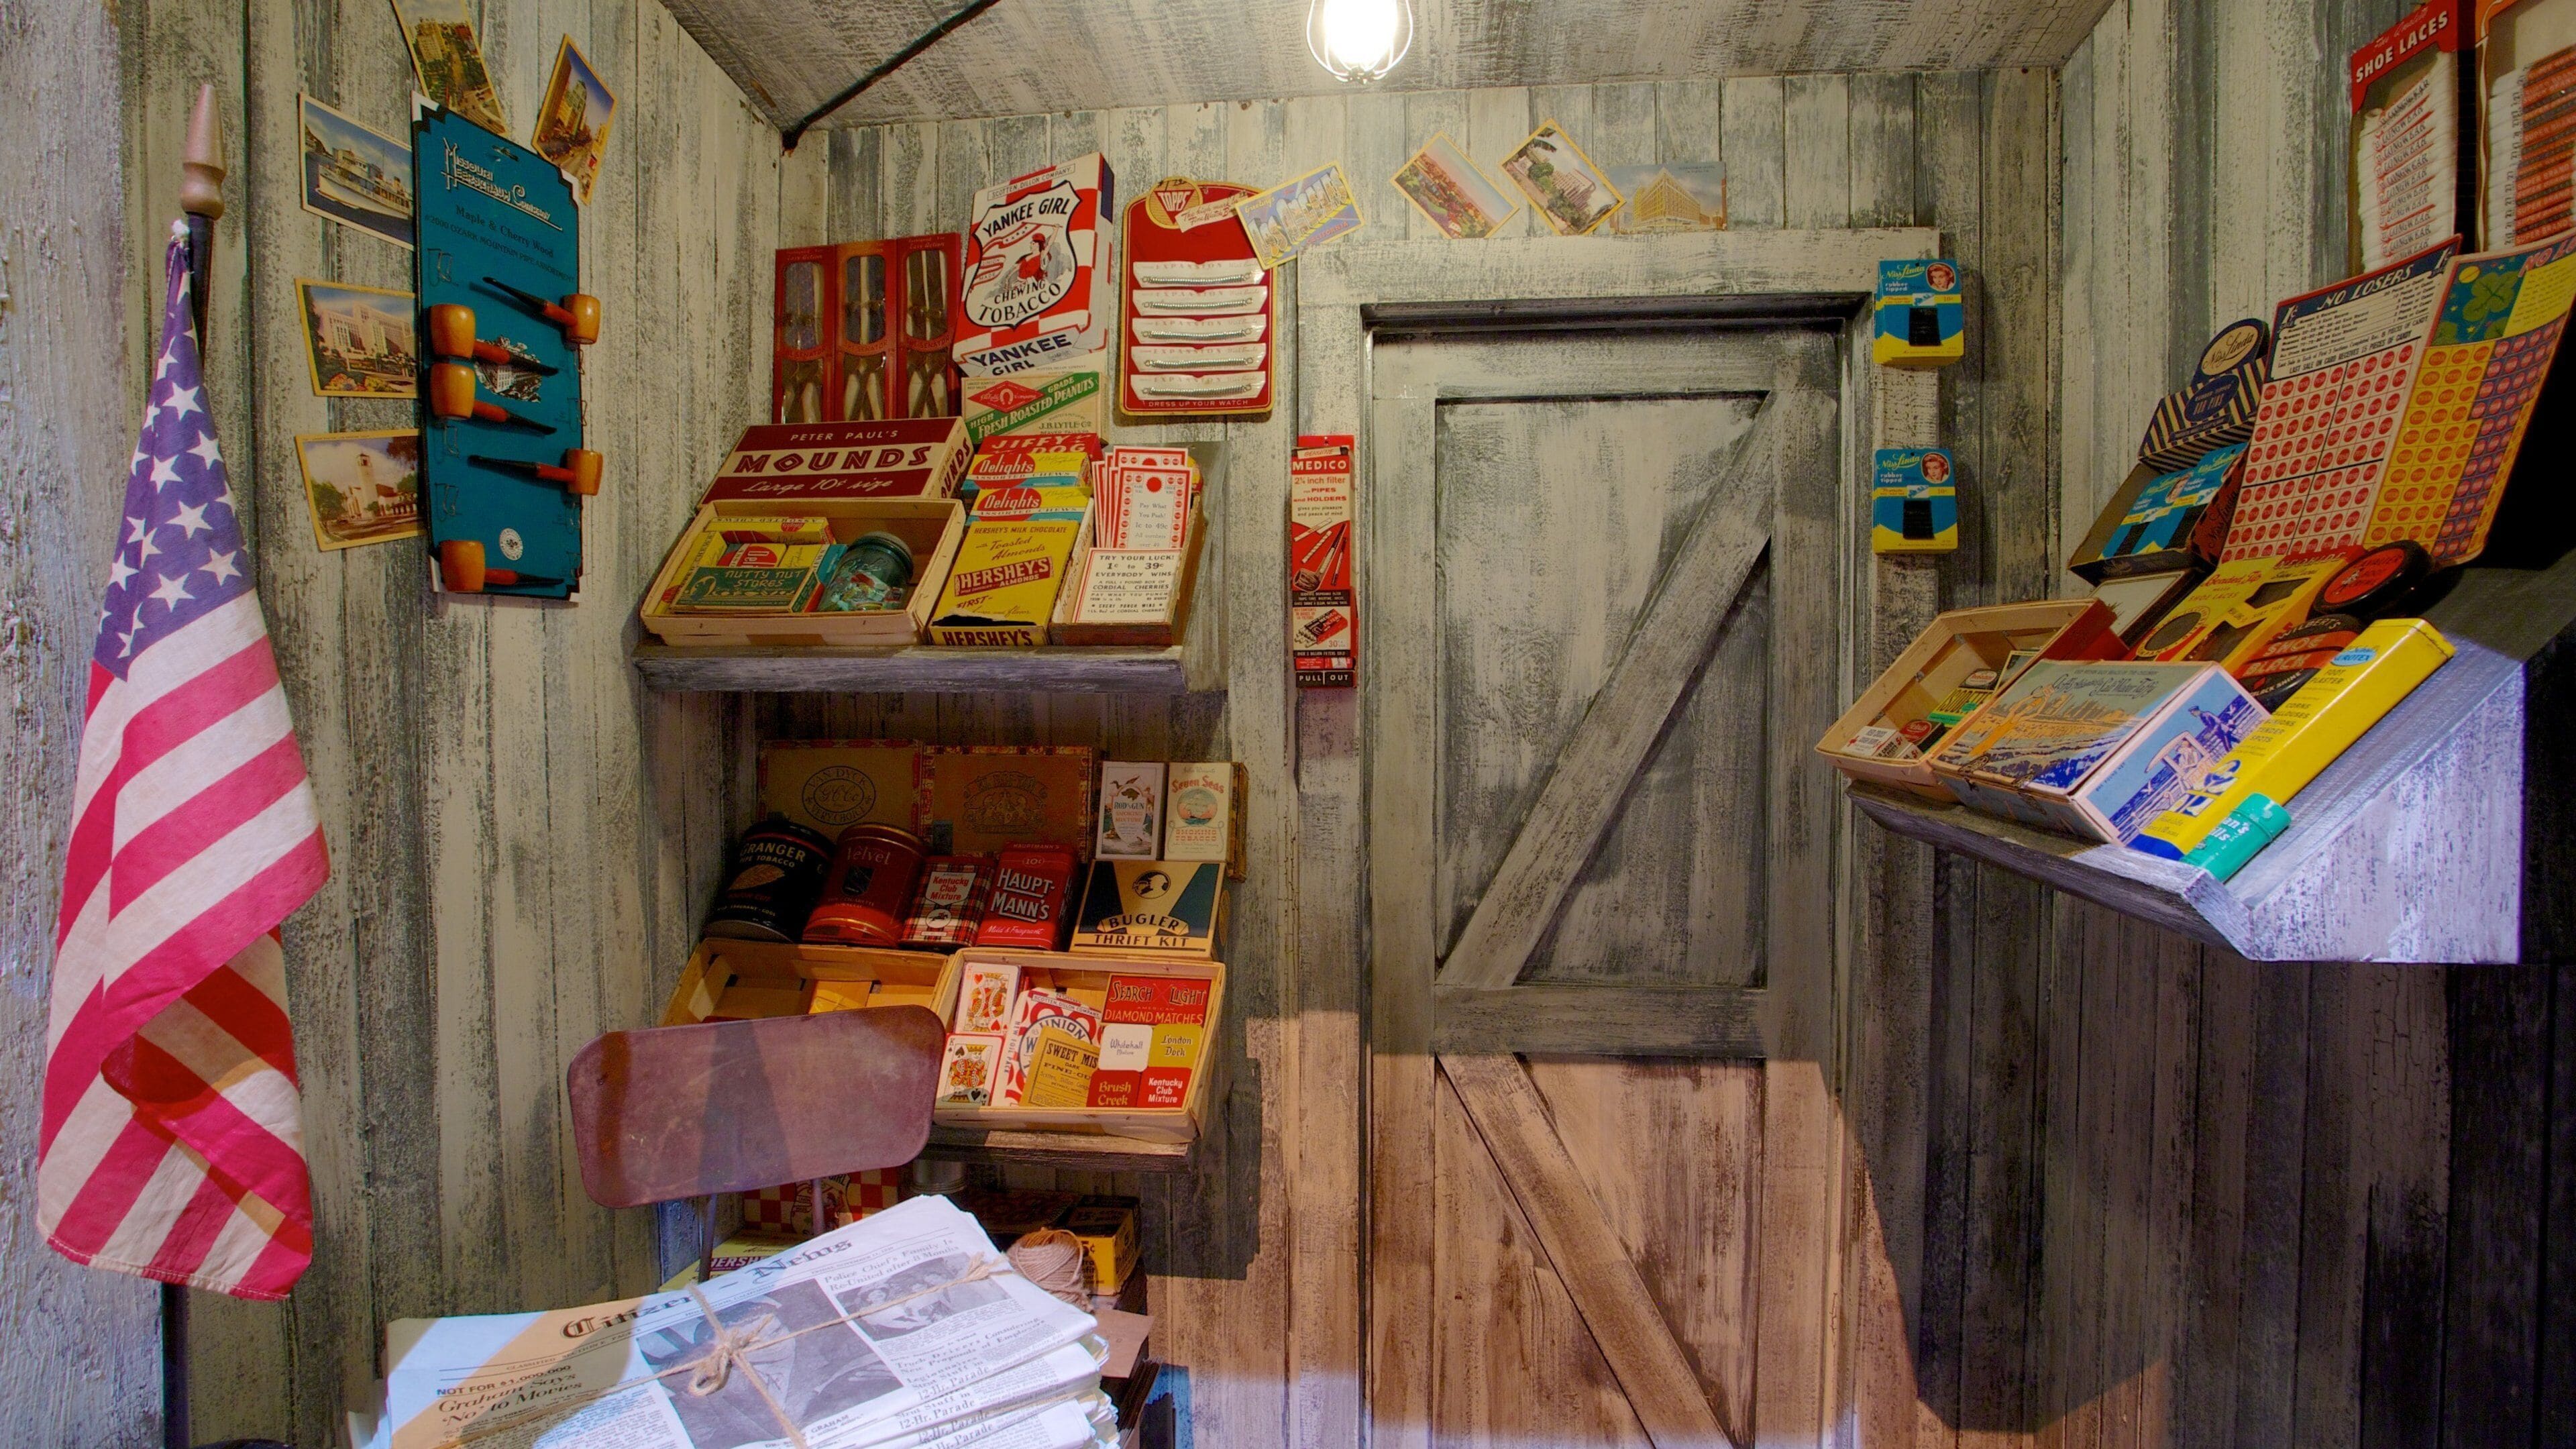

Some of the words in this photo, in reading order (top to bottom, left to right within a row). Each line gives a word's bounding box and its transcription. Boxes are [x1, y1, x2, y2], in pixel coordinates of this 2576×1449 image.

[2356, 46, 2394, 83] SHOE
[2399, 11, 2448, 55] LACES
[992, 184, 1017, 198] SCOTTEN
[1020, 176, 1040, 189] DILLON
[1157, 191, 1191, 212] TOPPS
[983, 202, 1034, 237] YANKEE
[1038, 197, 1070, 215] GIRL
[455, 205, 485, 227] Maple
[488, 221, 496, 230] &
[500, 225, 530, 248] Cherry
[533, 239, 553, 258] Wood
[979, 272, 996, 280] MADE
[994, 280, 1046, 305] CHEWING
[2316, 290, 2347, 311] NO
[2350, 264, 2415, 300] LOSERS
[978, 282, 1061, 323] TOBACCO
[969, 334, 1072, 367] YANKEE
[2226, 331, 2255, 362] Linda
[2290, 364, 2302, 374] LAST
[2324, 356, 2337, 364] CARD
[2368, 341, 2385, 352] PIECES
[2395, 330, 2412, 341] CANDY
[991, 359, 1035, 376] GIRL
[1048, 376, 1075, 393] GRADE
[977, 417, 1008, 439] FRESH
[1010, 396, 1053, 424] ROASTED
[1053, 376, 1095, 405] PEANUTS
[969, 413, 994, 429] HIGH
[790, 432, 833, 441] PETER
[845, 429, 899, 440] PAUL'S
[991, 435, 1070, 449] JIFFY
[733, 445, 932, 474] MOUNDS
[979, 456, 1034, 474] Delights
[1292, 460, 1347, 470] MEDICO
[742, 480, 806, 492] Large
[849, 477, 894, 492] size
[1307, 476, 1324, 484] inch
[1326, 476, 1346, 484] filter
[984, 490, 1040, 509] Delights
[1030, 526, 1068, 534] CHOCOLATE
[989, 536, 1033, 551] Toasted
[991, 545, 1046, 561] Almonds
[724, 570, 769, 578] NUTTY
[775, 570, 804, 578] NUT
[961, 557, 1049, 588] HERSHEY'S
[999, 574, 1040, 588] ALMONDS
[737, 578, 785, 588] STORES
[942, 629, 1034, 646] HERSHEY'S
[2278, 618, 2341, 639] WILBERT'S
[2263, 633, 2327, 657] SHOE
[2243, 652, 2312, 678] BLACK
[808, 768, 833, 788] VAN
[836, 767, 867, 786] DYCK
[1171, 778, 1200, 794] Seven
[1201, 775, 1225, 794] Seas
[810, 804, 833, 821] VERY
[833, 804, 866, 821] CHOICE
[740, 841, 806, 863] GRANGER
[756, 854, 796, 869] TOBACCO
[932, 875, 969, 886] Kentucky
[940, 884, 957, 893] Club
[996, 867, 1055, 895] HAUPT-
[930, 892, 962, 900] Mixture
[990, 891, 1051, 920] MANN'S
[1010, 926, 1044, 936] Fragrant
[1109, 913, 1180, 930] BUGLER
[1094, 933, 1157, 947] THRIFT
[1159, 937, 1190, 948] KIT
[1109, 980, 1153, 1002] SEARCH
[1169, 987, 1207, 1006] LIGHT
[1104, 1009, 1154, 1023] DIAMOND
[1155, 1010, 1204, 1026] MATCHES
[1110, 1038, 1143, 1050] Whitehall
[1161, 1034, 1192, 1045] London
[1046, 1042, 1079, 1062] SWEET
[1164, 1046, 1185, 1057] Dock
[1065, 1061, 1081, 1070] DARK
[1098, 1081, 1132, 1093] Brush
[1148, 1077, 1183, 1089] Kentucky
[1156, 1085, 1173, 1095] Club
[1097, 1094, 1128, 1106] Creek
[1148, 1094, 1178, 1104] Mixture
[824, 1270, 856, 1285] Police
[861, 1255, 898, 1274] Chief's
[902, 1244, 941, 1259] Family
[829, 1267, 885, 1292] Re-United
[885, 1258, 911, 1273] after
[921, 1244, 960, 1259] Months
[559, 1295, 694, 1339] Citizen
[745, 1239, 853, 1284] News
[928, 1348, 976, 1367] Proposals
[996, 1320, 1045, 1343] Employers
[932, 1339, 981, 1359] Drivers
[985, 1317, 1040, 1340] Considering
[506, 1357, 555, 1371] CLASSIFIED
[906, 1356, 978, 1385] Legionnaires
[437, 1387, 464, 1396] NOT
[470, 1383, 495, 1393] FOR
[500, 1365, 572, 1387] $1,000,000
[950, 1364, 990, 1387] Parade
[438, 1385, 524, 1413] Graham
[529, 1373, 577, 1389] Says
[490, 1400, 509, 1412] to
[515, 1382, 582, 1405] Movies
[810, 1413, 851, 1434] GRAHAM
[898, 1413, 932, 1430] 12-Hr.
[933, 1398, 975, 1419] Parade
[950, 1409, 990, 1432] Parade
[954, 1421, 994, 1444] Parade
